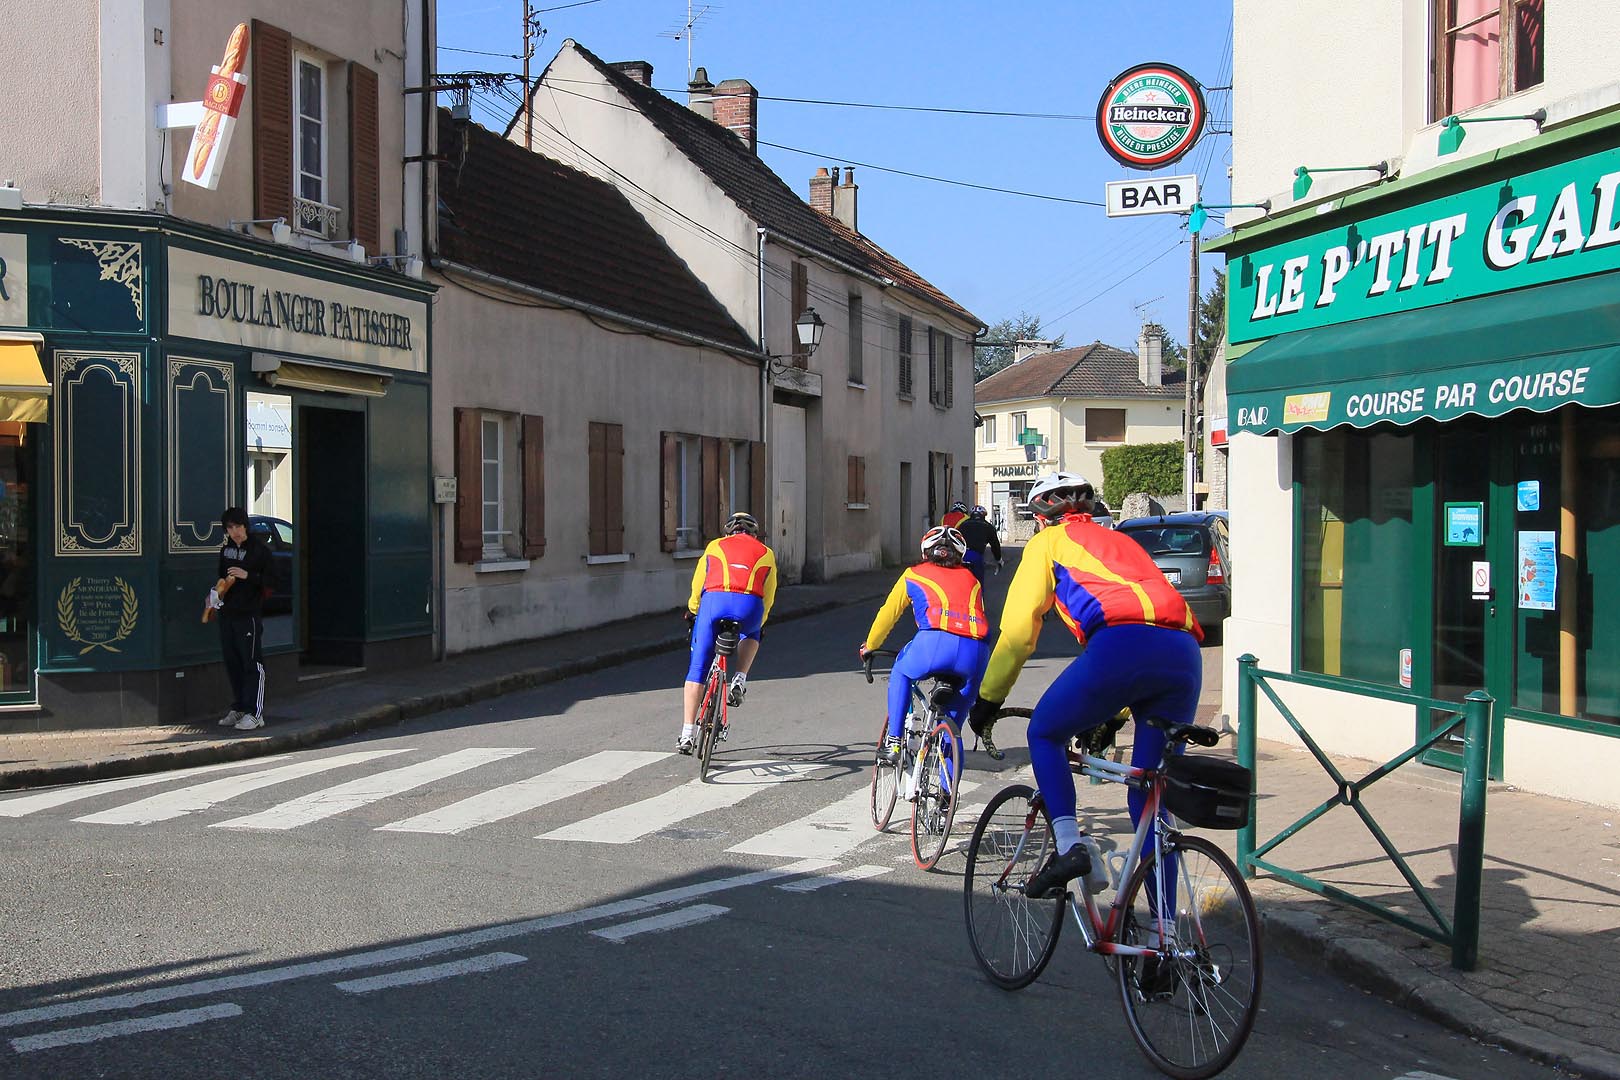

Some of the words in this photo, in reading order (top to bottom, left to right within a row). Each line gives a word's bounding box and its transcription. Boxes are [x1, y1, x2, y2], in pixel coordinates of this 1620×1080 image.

[1113, 106, 1186, 122] Heineken
[1135, 142, 1145, 152] DE
[1146, 131, 1181, 152] PRESTIGE
[1121, 183, 1182, 209] BAR
[1250, 254, 1310, 322] LE
[1315, 212, 1468, 308] P'TIT
[198, 274, 327, 337] BOULANGER
[330, 301, 413, 351] PATISSIER
[1346, 387, 1425, 418] COURSE
[1434, 382, 1477, 410] PAR
[1488, 366, 1591, 404] COURSE
[1237, 406, 1269, 427] BAR
[89, 609, 97, 617] de
[98, 609, 120, 617] France
[96, 601, 111, 609] Prix
